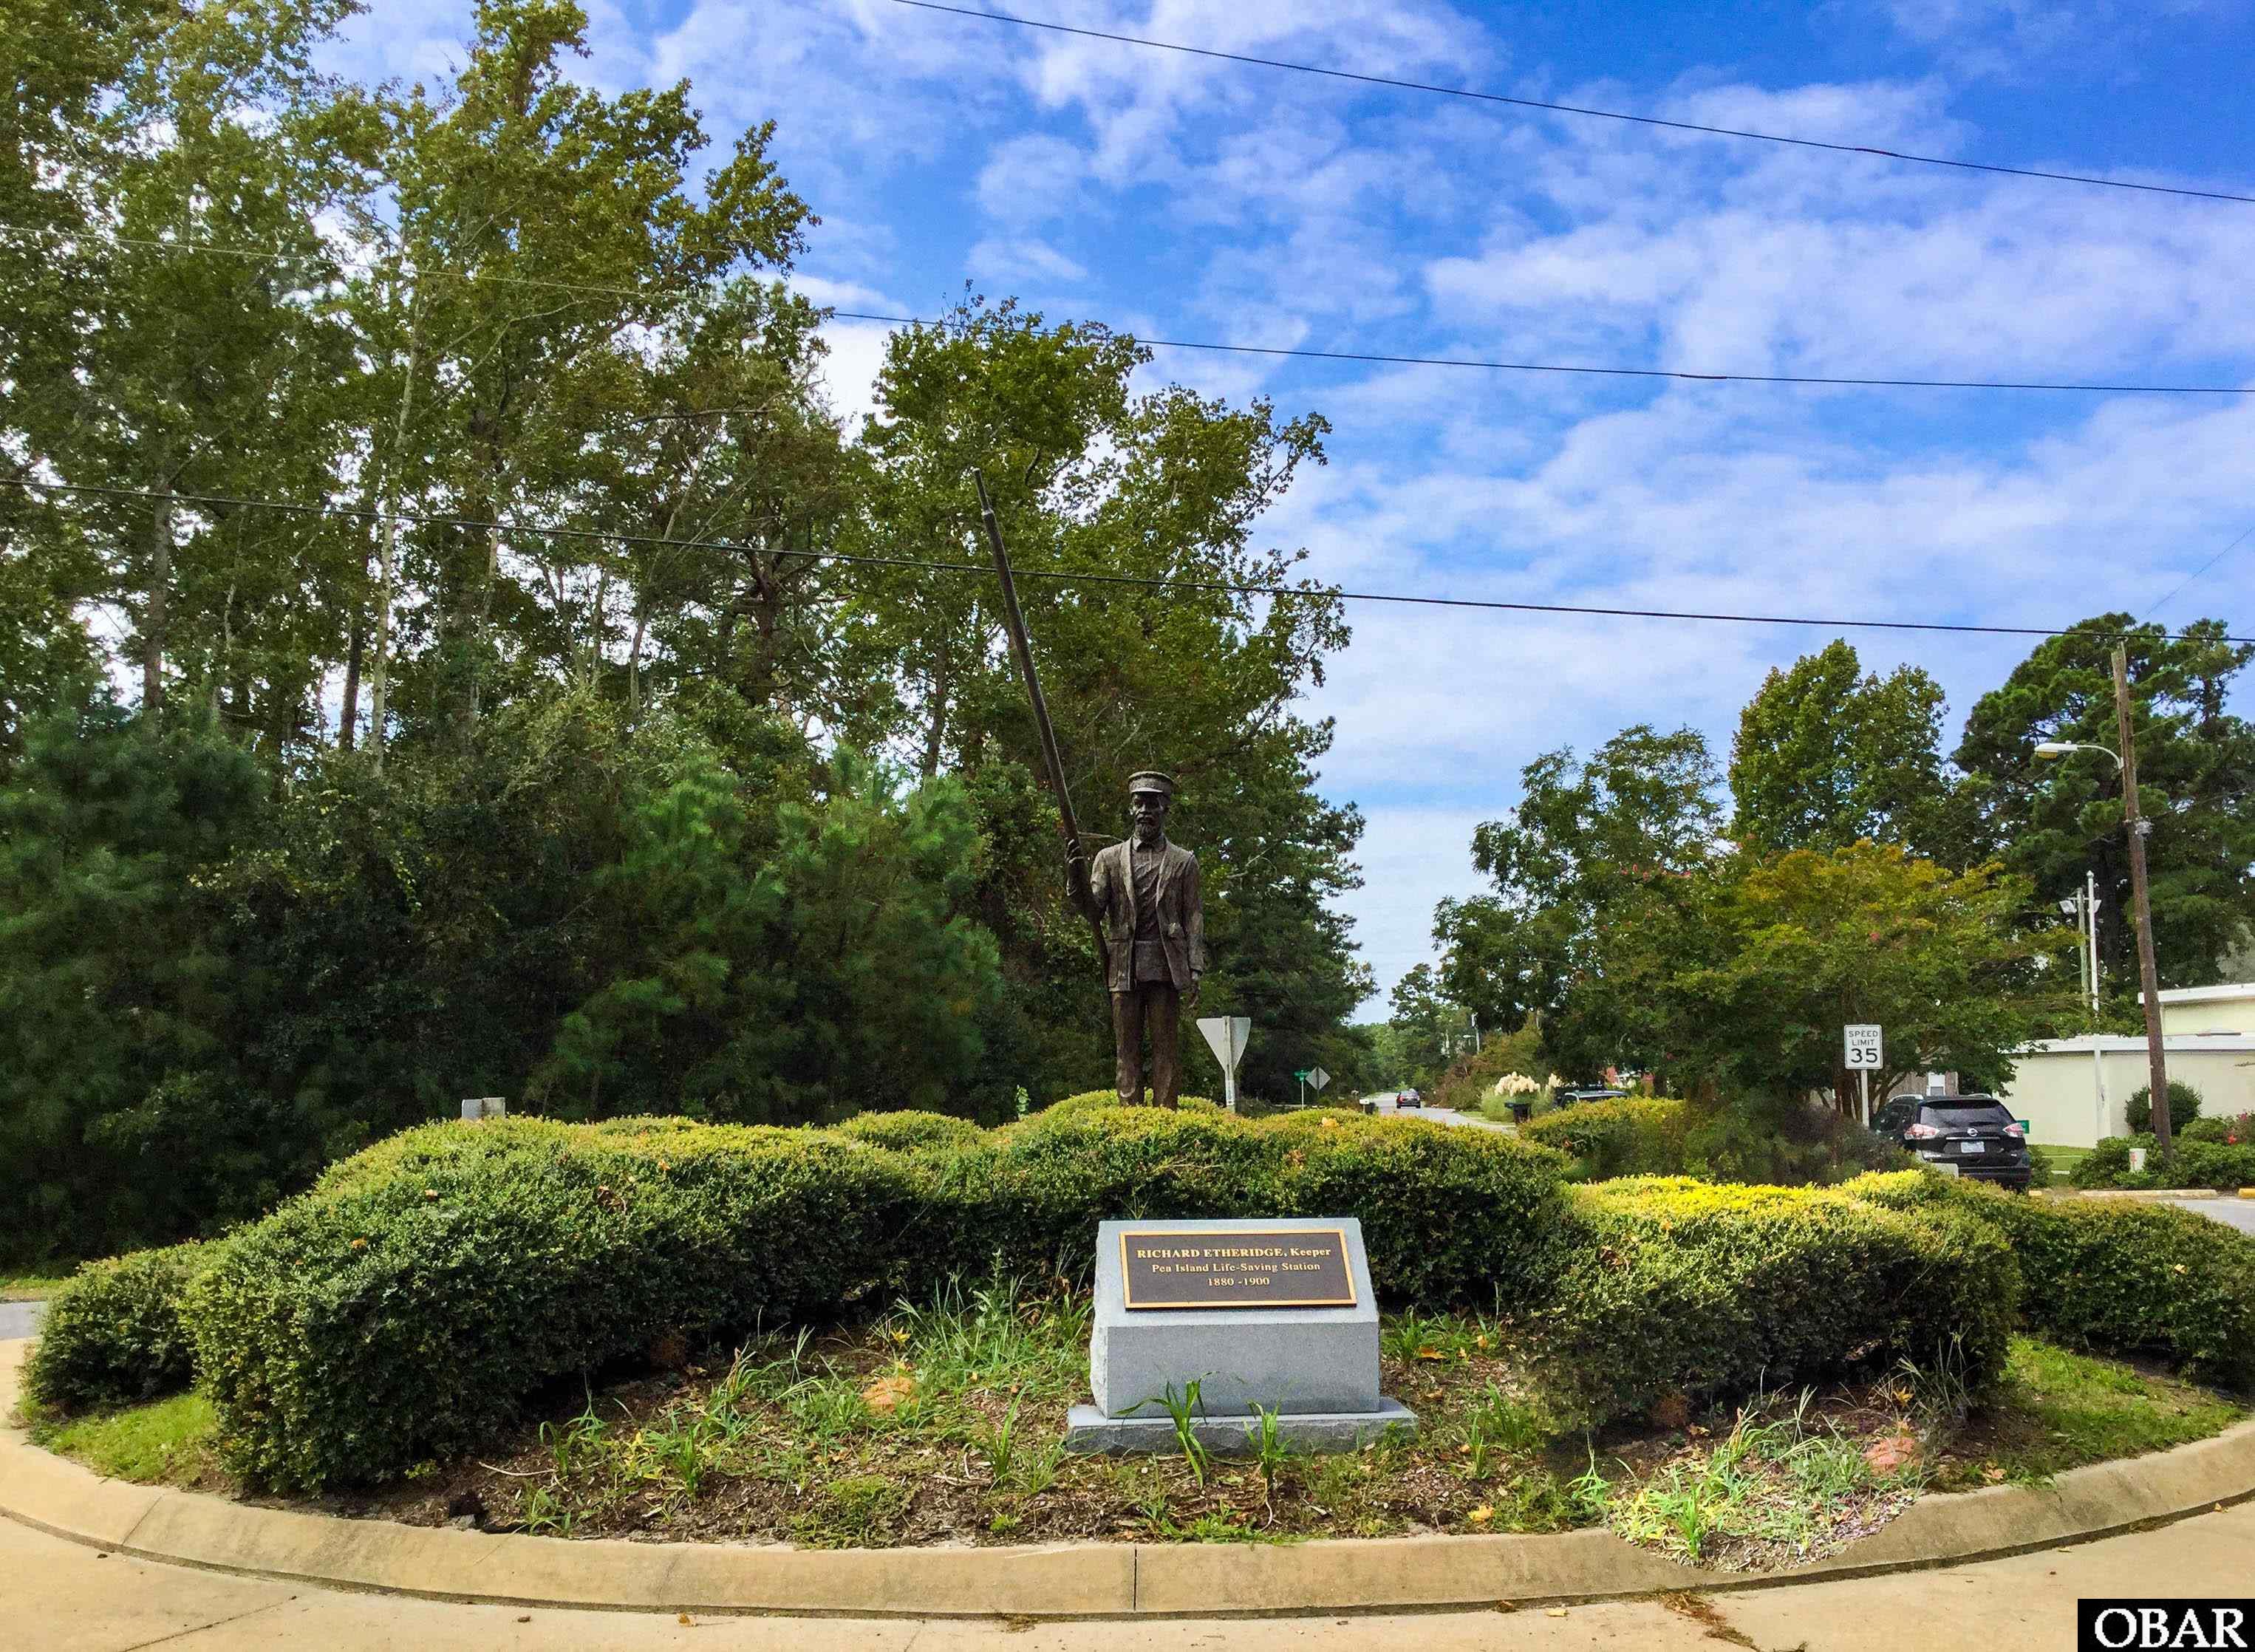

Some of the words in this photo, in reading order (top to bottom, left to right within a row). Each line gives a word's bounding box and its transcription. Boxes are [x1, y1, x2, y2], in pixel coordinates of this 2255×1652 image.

[1851, 1048, 1877, 1063] 35
[1137, 1249, 1200, 1258] RICHARD
[1204, 1248, 1287, 1257] ETHERIDGE,
[1290, 1247, 1331, 1257] Keeper
[1152, 1264, 1171, 1272] Pea
[1176, 1264, 1209, 1272] Island
[1213, 1263, 1278, 1273] Life-Saving
[1282, 1262, 1320, 1271] Station
[1208, 1277, 1235, 1286] 1880
